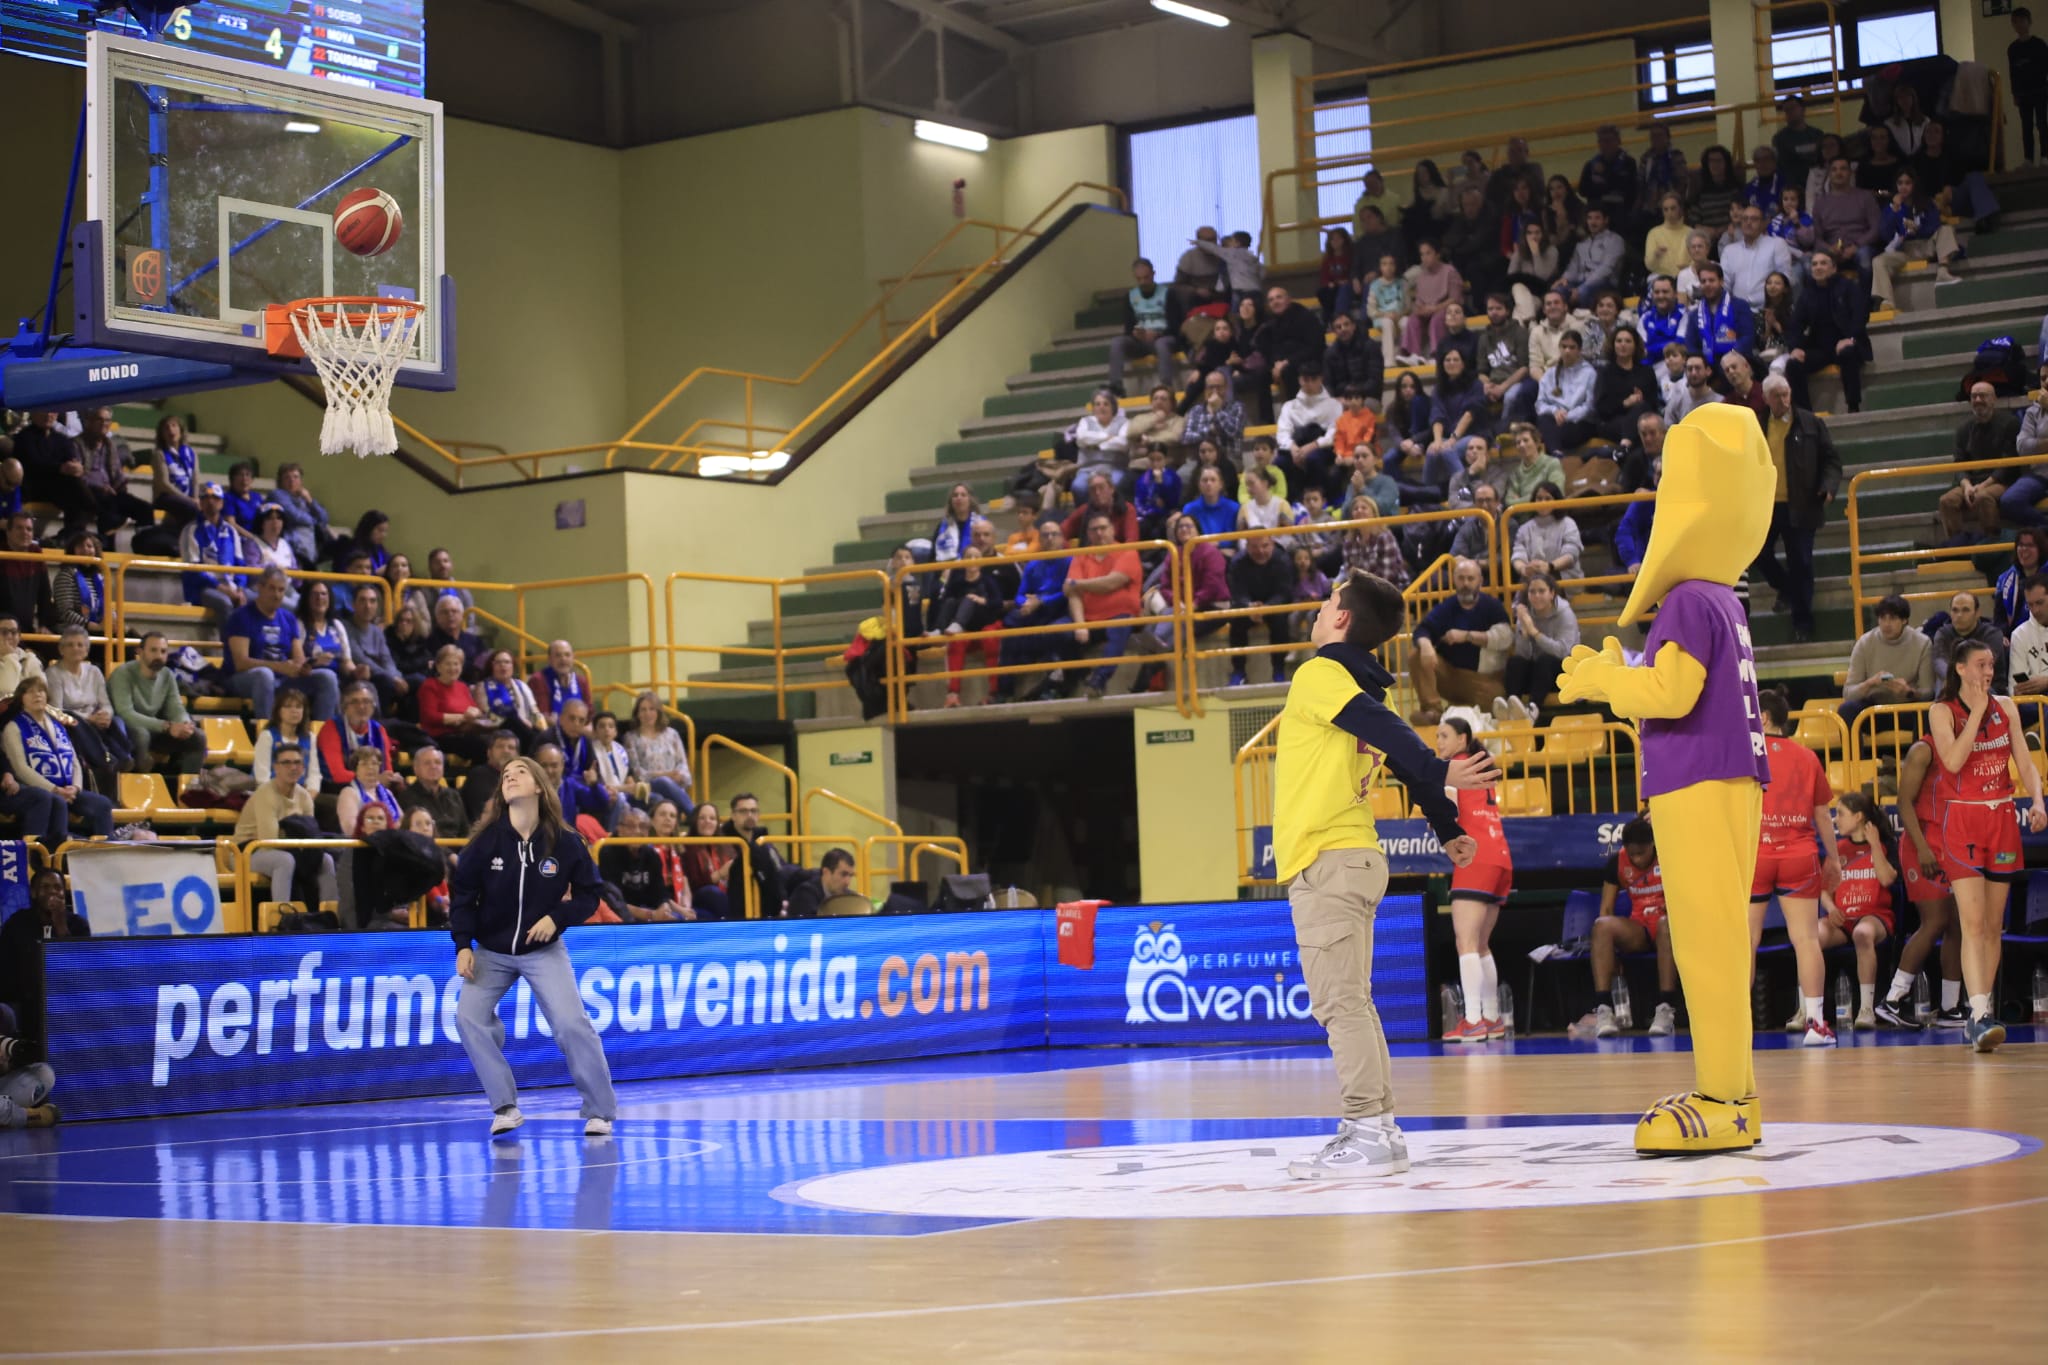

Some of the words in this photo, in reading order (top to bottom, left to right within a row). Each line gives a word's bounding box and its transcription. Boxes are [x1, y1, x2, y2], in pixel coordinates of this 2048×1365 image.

[265, 27, 283, 60] 4
[89, 364, 139, 382] MONDO
[1973, 732, 2009, 752] EMBIBRE
[1188, 951, 1301, 969] PERFUME
